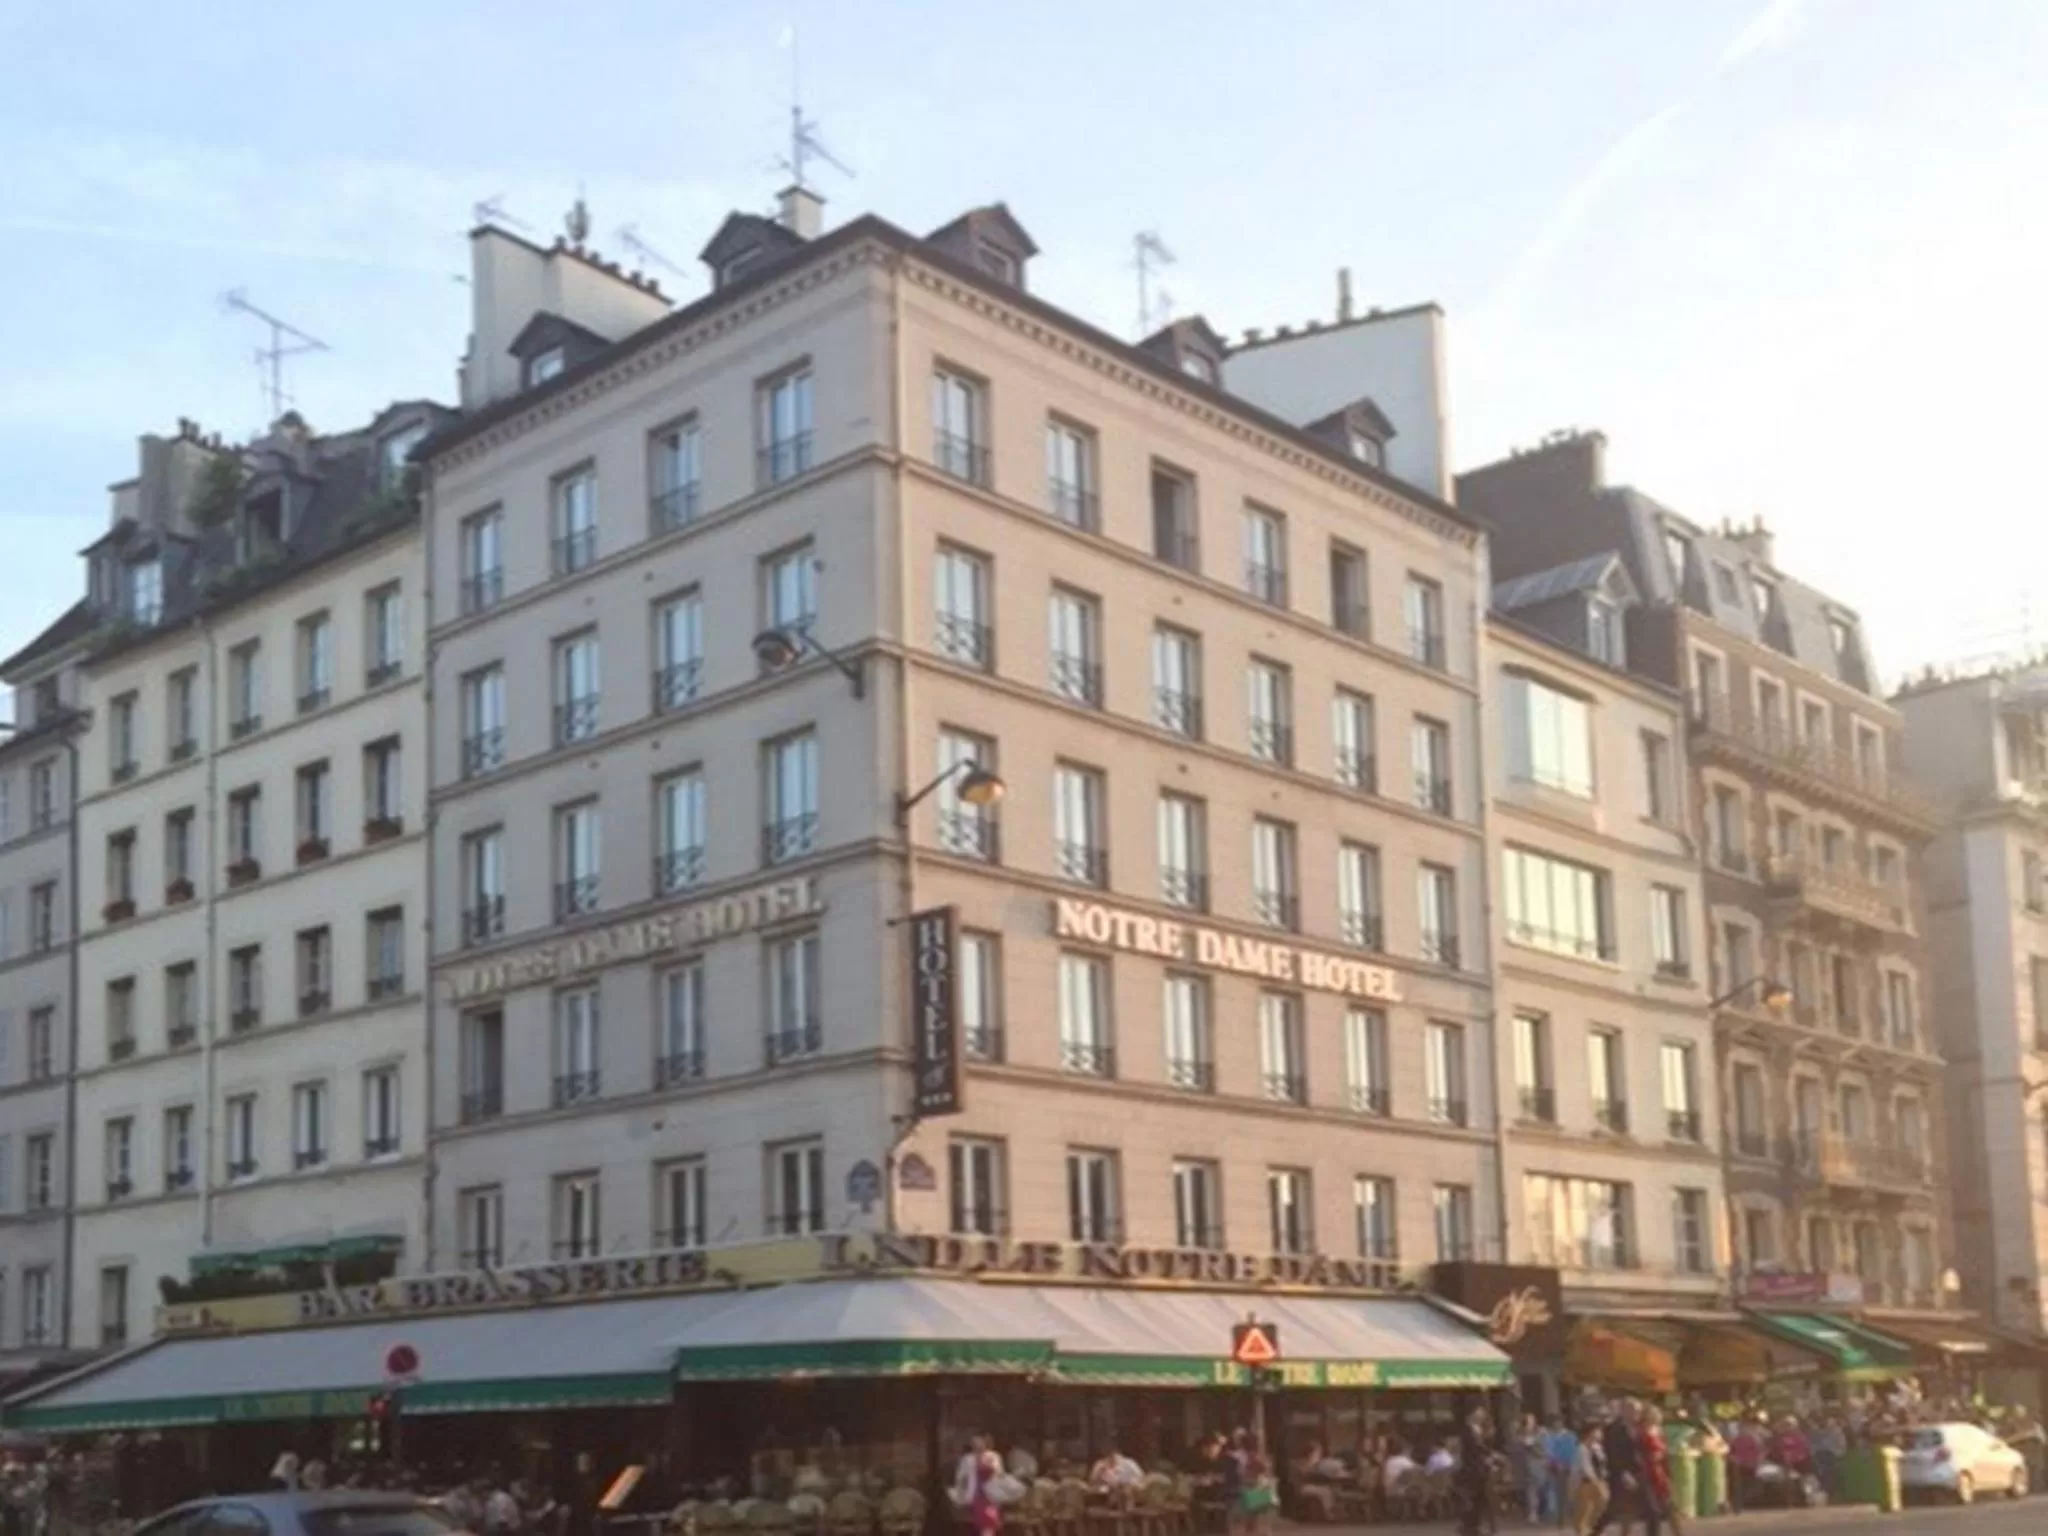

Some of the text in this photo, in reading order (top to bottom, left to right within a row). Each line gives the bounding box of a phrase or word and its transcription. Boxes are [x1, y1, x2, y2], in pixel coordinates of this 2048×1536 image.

[687, 876, 824, 938] HOTEL
[1056, 897, 1404, 1002] NOTRE DAME HOTEL
[918, 917, 949, 1061] HOTEL
[297, 1250, 707, 1318] BAR BRASSERIE
[1079, 1244, 1259, 1283] NOTRE
